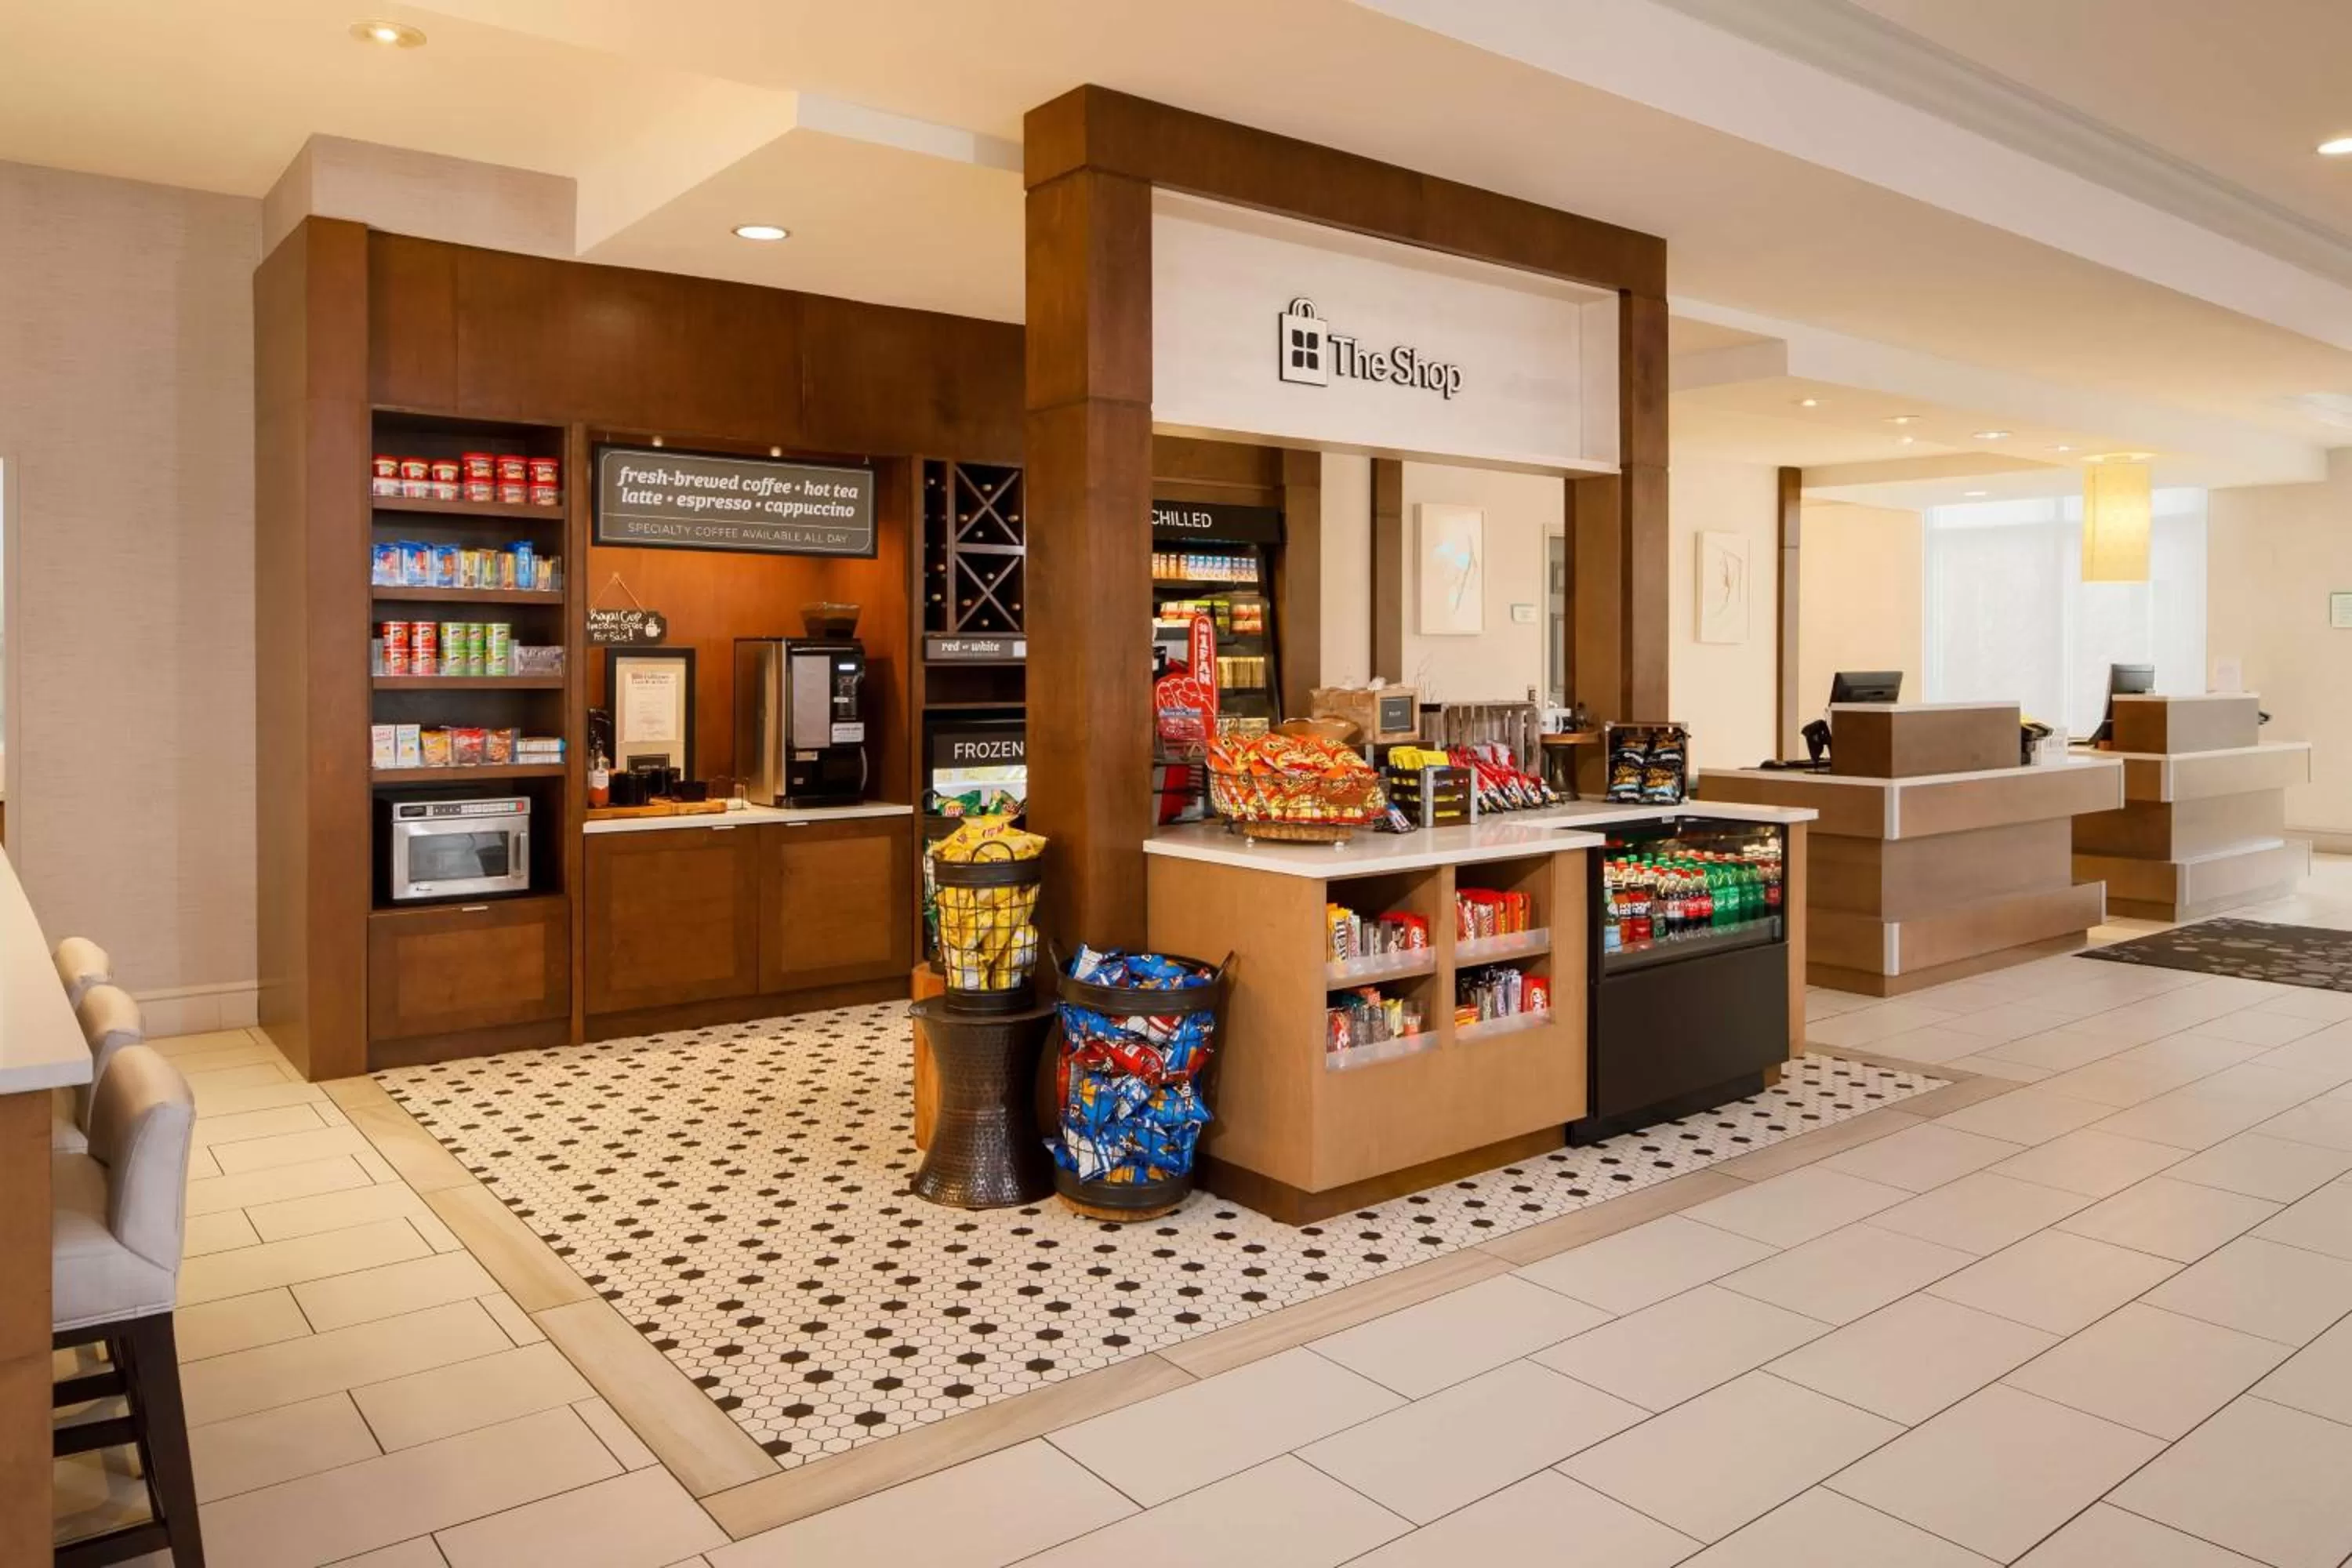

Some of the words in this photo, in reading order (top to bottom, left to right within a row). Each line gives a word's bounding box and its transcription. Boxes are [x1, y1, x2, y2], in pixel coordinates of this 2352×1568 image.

[1327, 334, 1388, 381] The
[1390, 346, 1463, 400] Shop
[617, 466, 739, 491] fresh-brewed
[742, 477, 792, 497] coffee
[804, 480, 832, 498] hot
[833, 485, 858, 499] tea
[621, 488, 662, 506] latte
[677, 494, 752, 512] espresso
[764, 499, 855, 518] cappuccino
[1152, 510, 1213, 528] CHILLED
[628, 522, 691, 536] SPECIALTY
[695, 526, 739, 539] COFFEE
[742, 530, 801, 543] AVAILABLE
[804, 532, 824, 543] ALL
[827, 534, 848, 544] DAY
[942, 641, 960, 652] red
[971, 641, 1000, 652] white
[954, 741, 1025, 760] FROZEN
